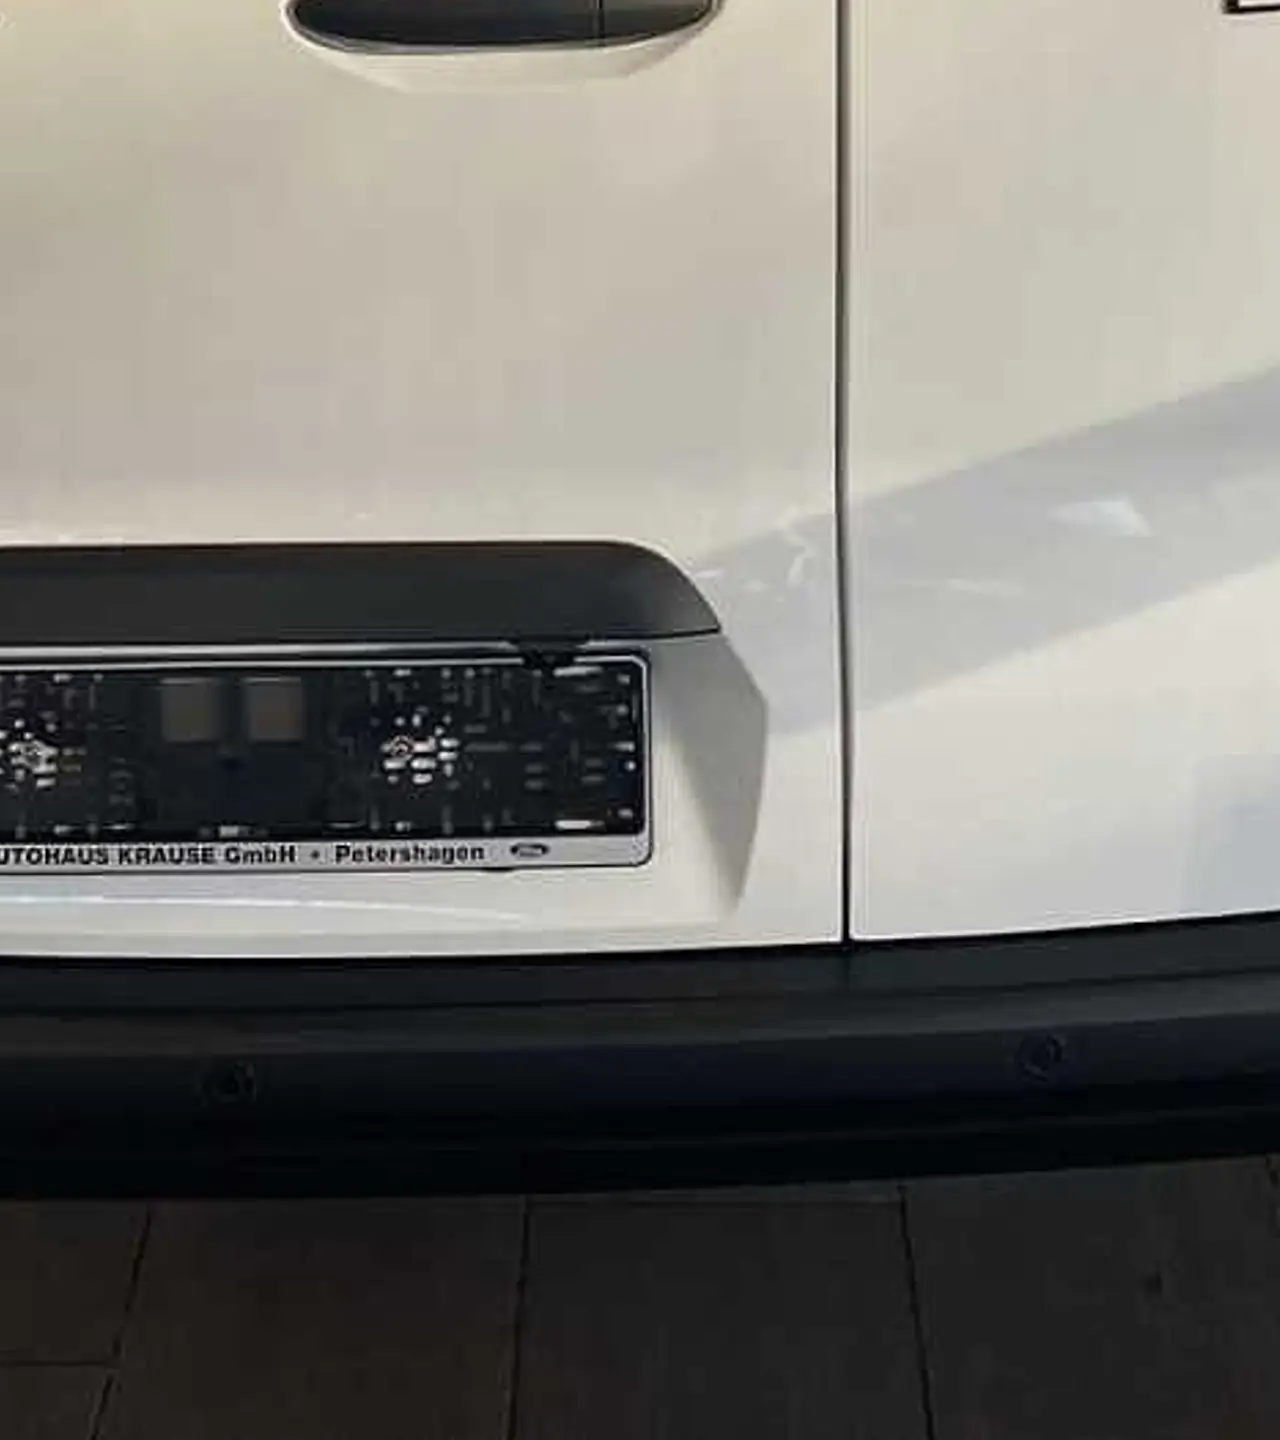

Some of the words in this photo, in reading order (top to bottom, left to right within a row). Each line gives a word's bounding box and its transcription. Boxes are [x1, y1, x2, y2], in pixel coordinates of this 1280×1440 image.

[118, 846, 215, 865] KRAUSE
[224, 844, 296, 864] GmbH
[335, 842, 486, 865] Petershagen
